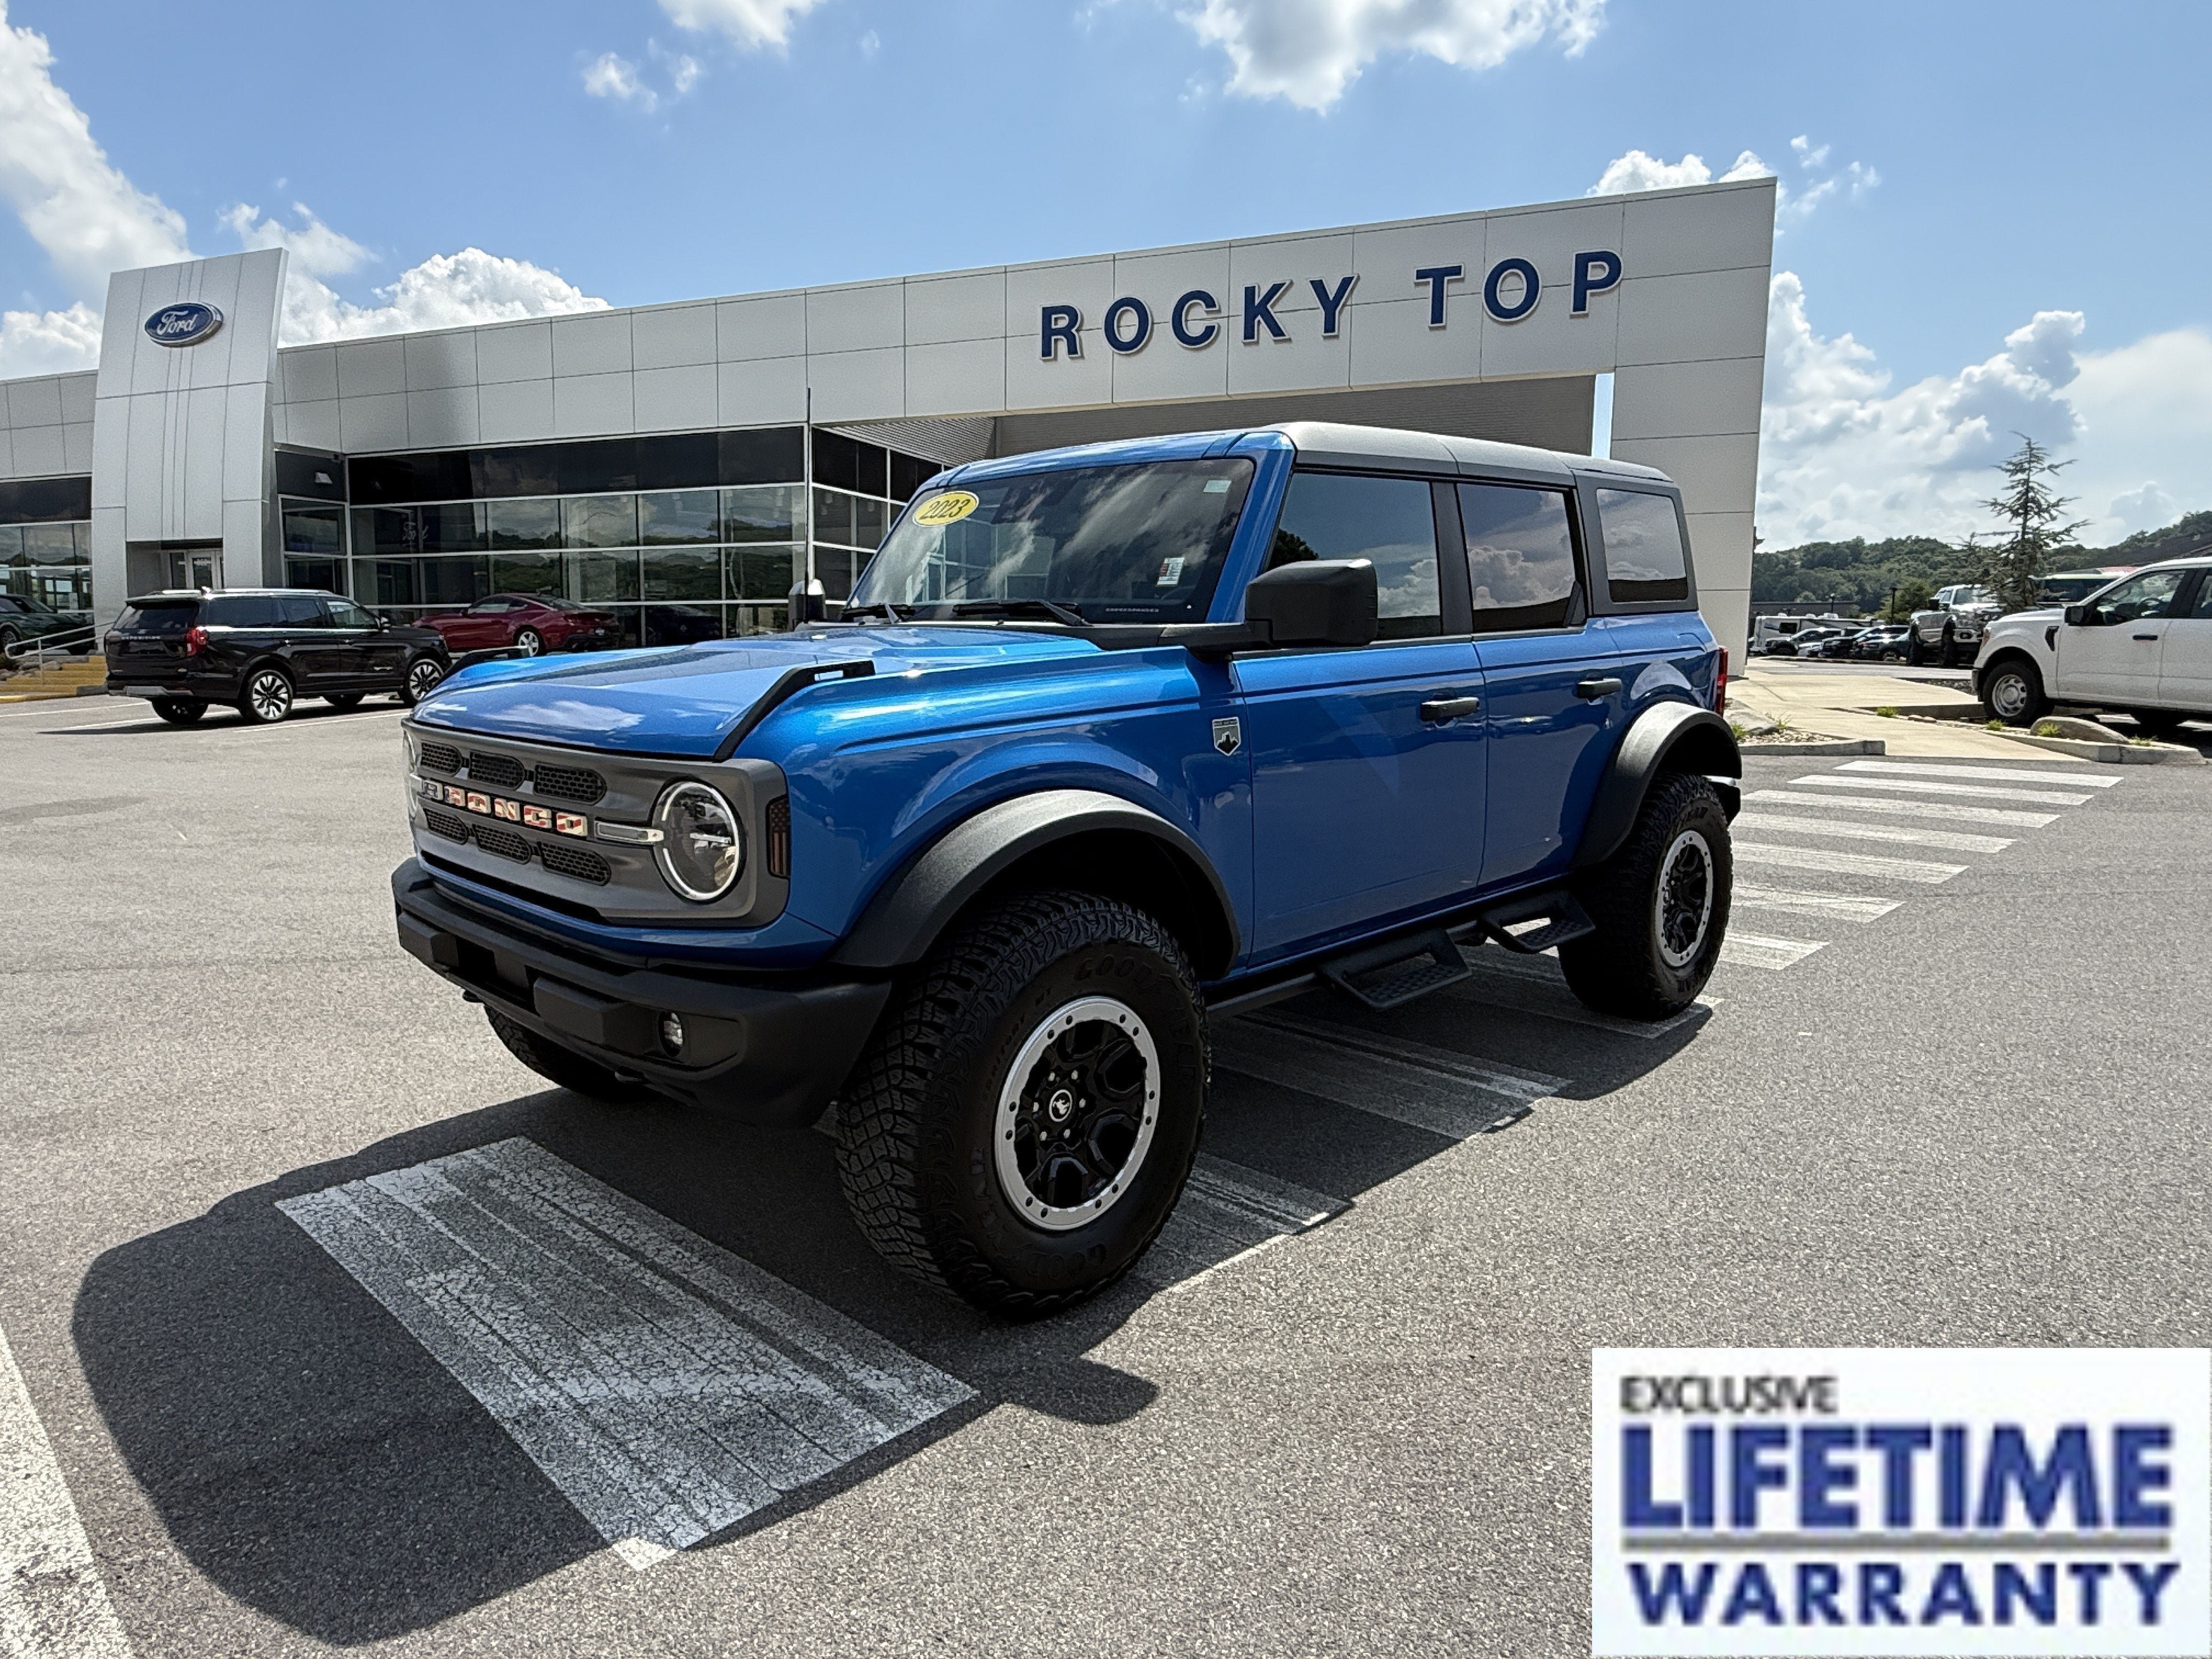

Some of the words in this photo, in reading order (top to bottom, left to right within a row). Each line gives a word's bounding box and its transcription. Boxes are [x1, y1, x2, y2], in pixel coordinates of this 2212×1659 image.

[157, 310, 198, 335] Ford
[1040, 273, 1358, 360] ROCKY
[1414, 249, 1623, 328] TOP
[918, 499, 970, 520] 2023
[421, 779, 588, 837] BRONCO
